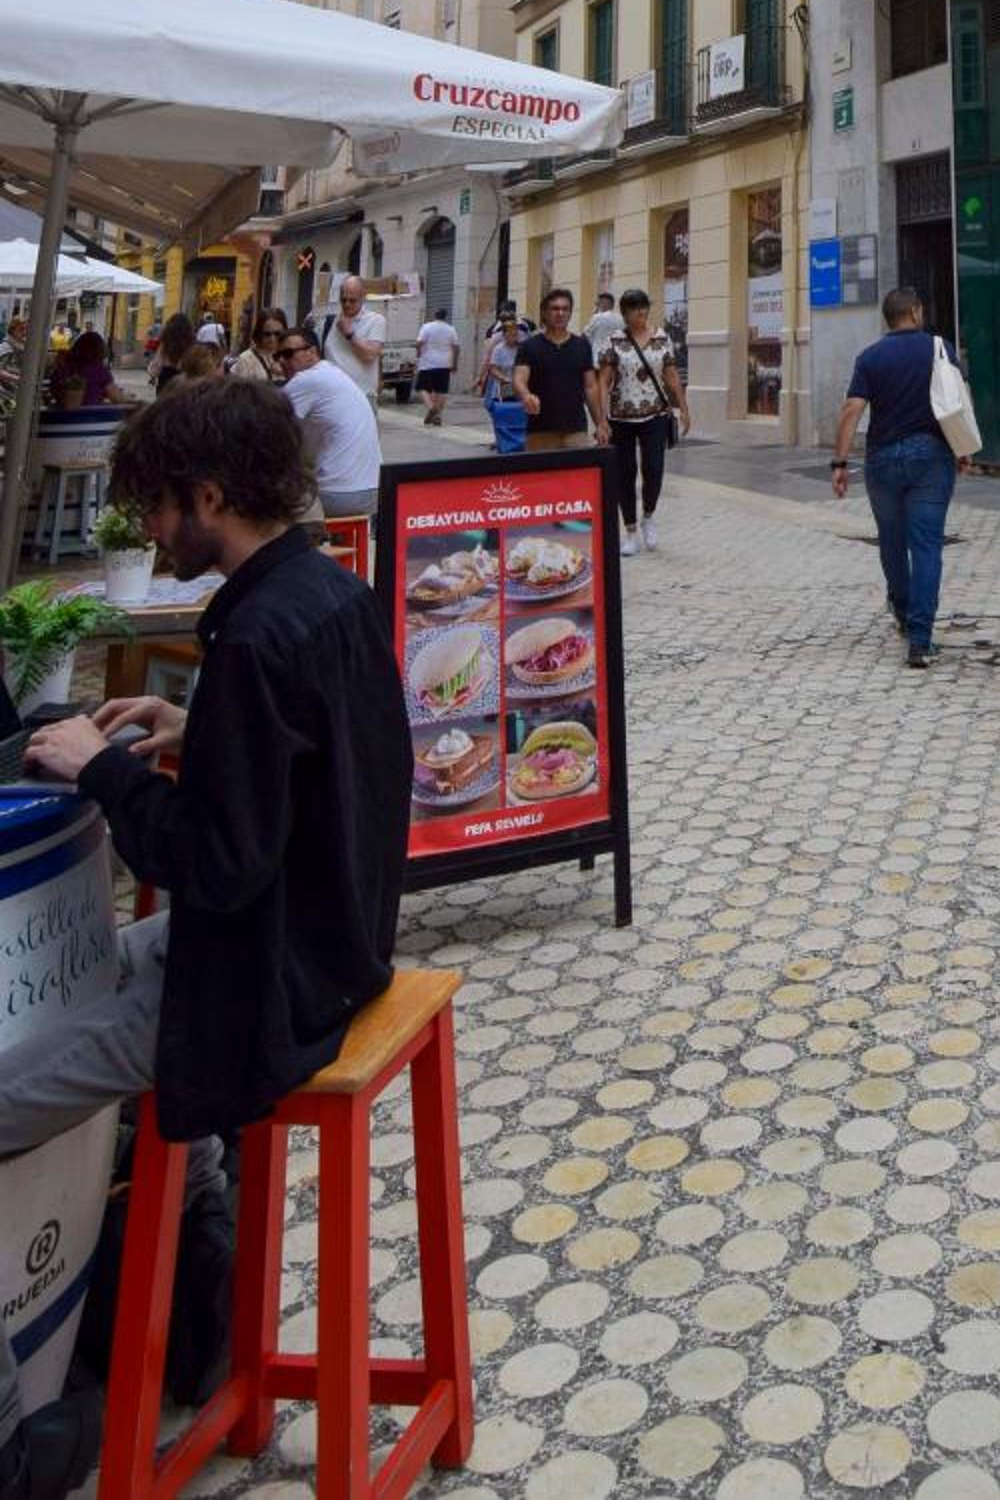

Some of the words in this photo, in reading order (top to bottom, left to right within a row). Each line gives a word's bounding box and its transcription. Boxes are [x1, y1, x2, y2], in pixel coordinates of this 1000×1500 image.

[413, 73, 581, 125] Cruzcampo
[406, 511, 485, 529] DESAYUNA
[488, 505, 531, 521] COMO
[535, 503, 553, 516] EN
[555, 500, 592, 515] CASA
[3, 1257, 65, 1321] RUEDA
